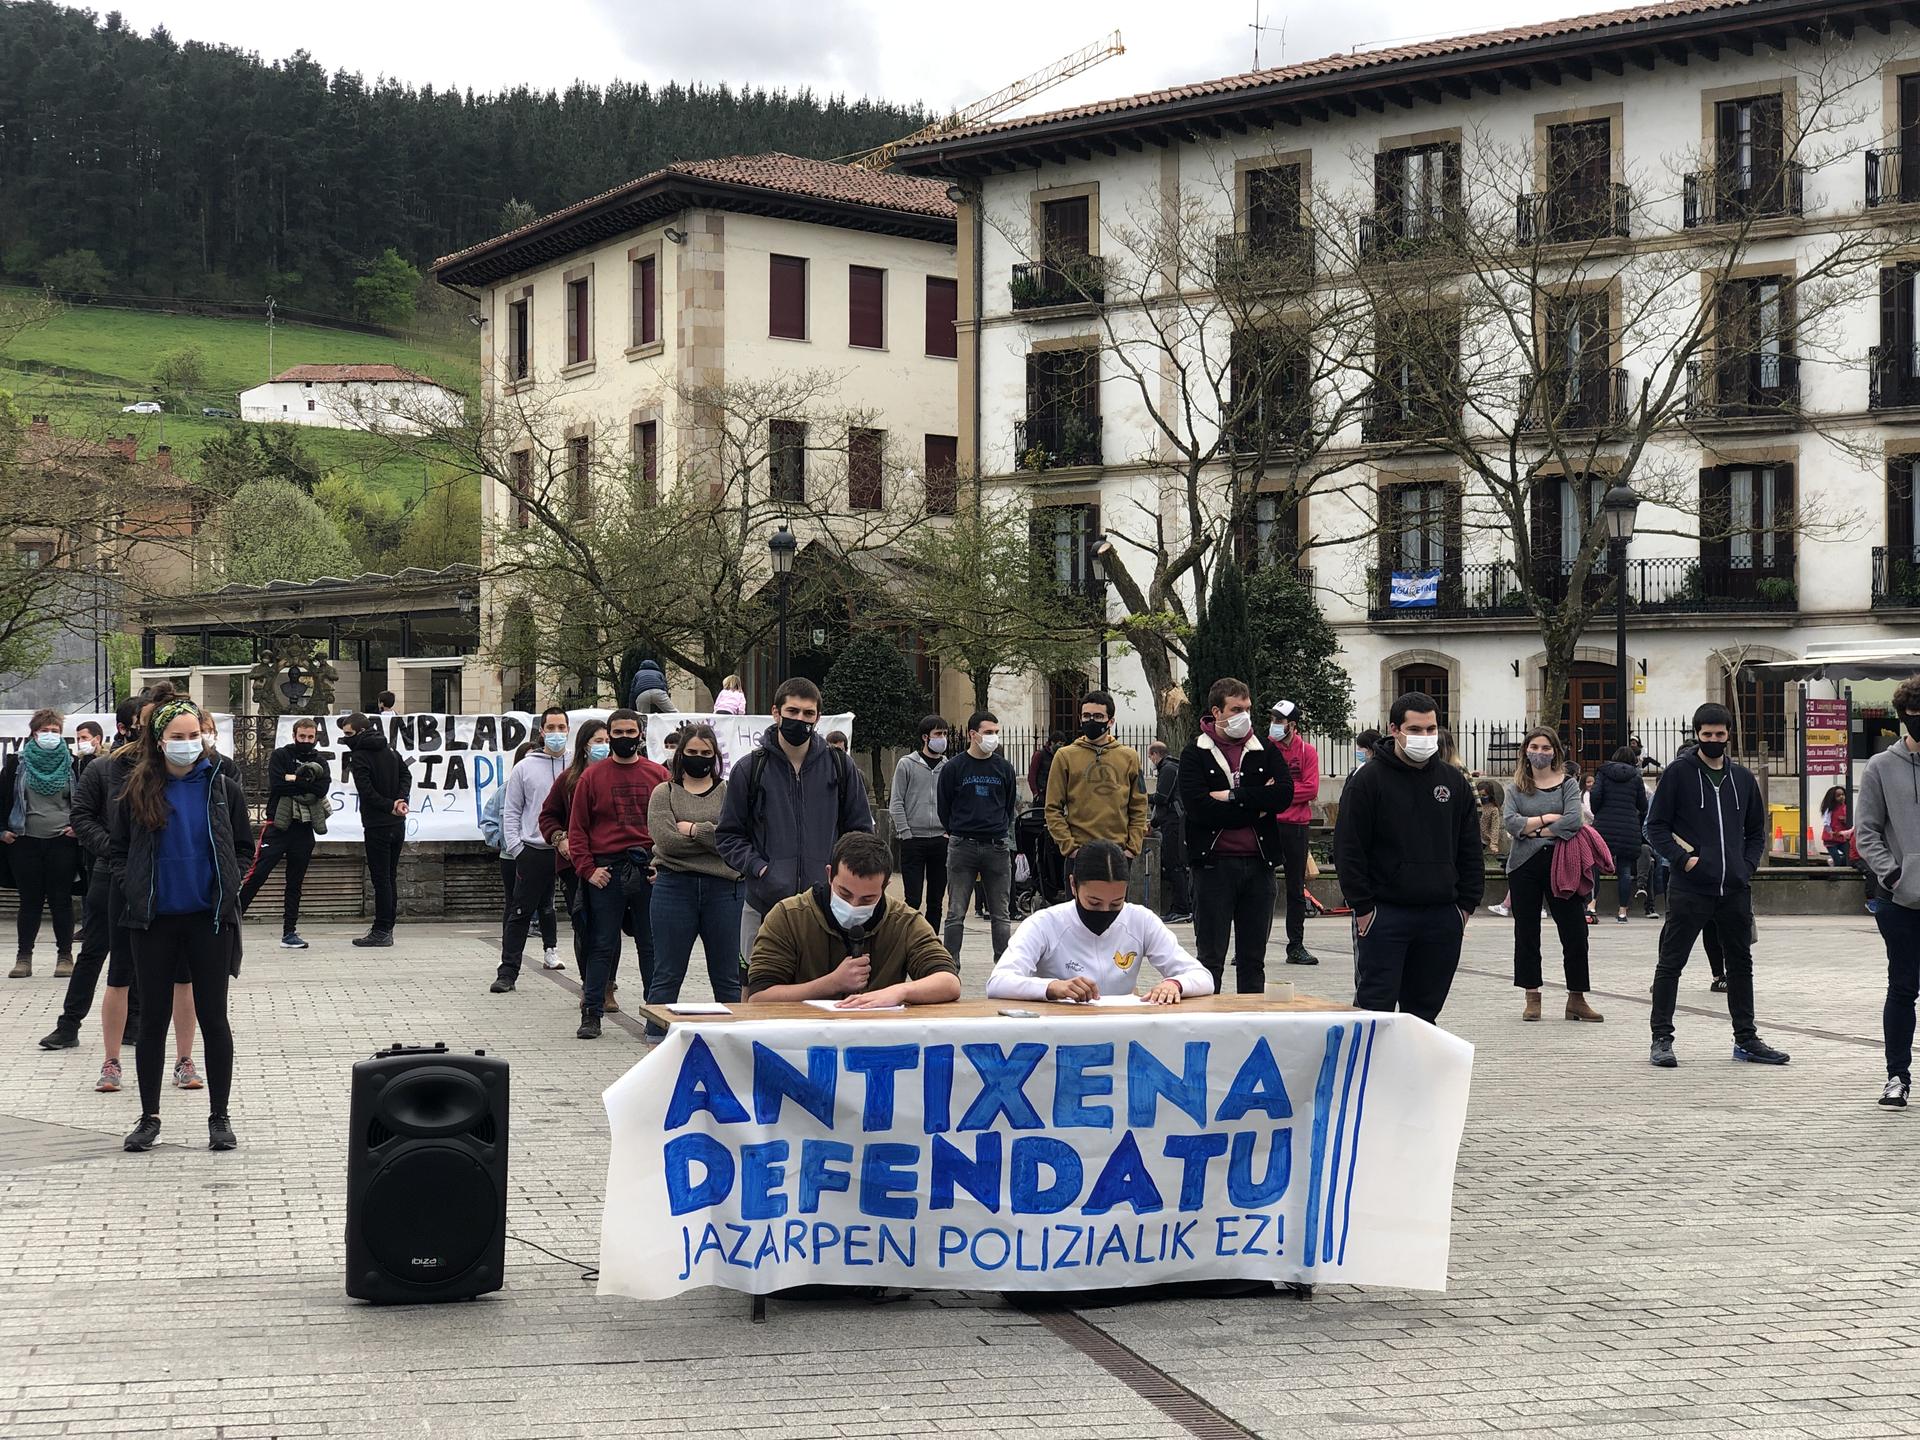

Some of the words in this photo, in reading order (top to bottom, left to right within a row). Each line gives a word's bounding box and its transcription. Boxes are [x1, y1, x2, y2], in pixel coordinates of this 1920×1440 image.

[663, 1033, 1294, 1134] ANTIXENA
[663, 1127, 1294, 1220] DEFENDATU
[411, 1257, 437, 1265] ibiza
[678, 1218, 915, 1280] JAZARPEN
[938, 1218, 1199, 1272] POLIZIALIK
[1215, 1213, 1285, 1257] EZ!
